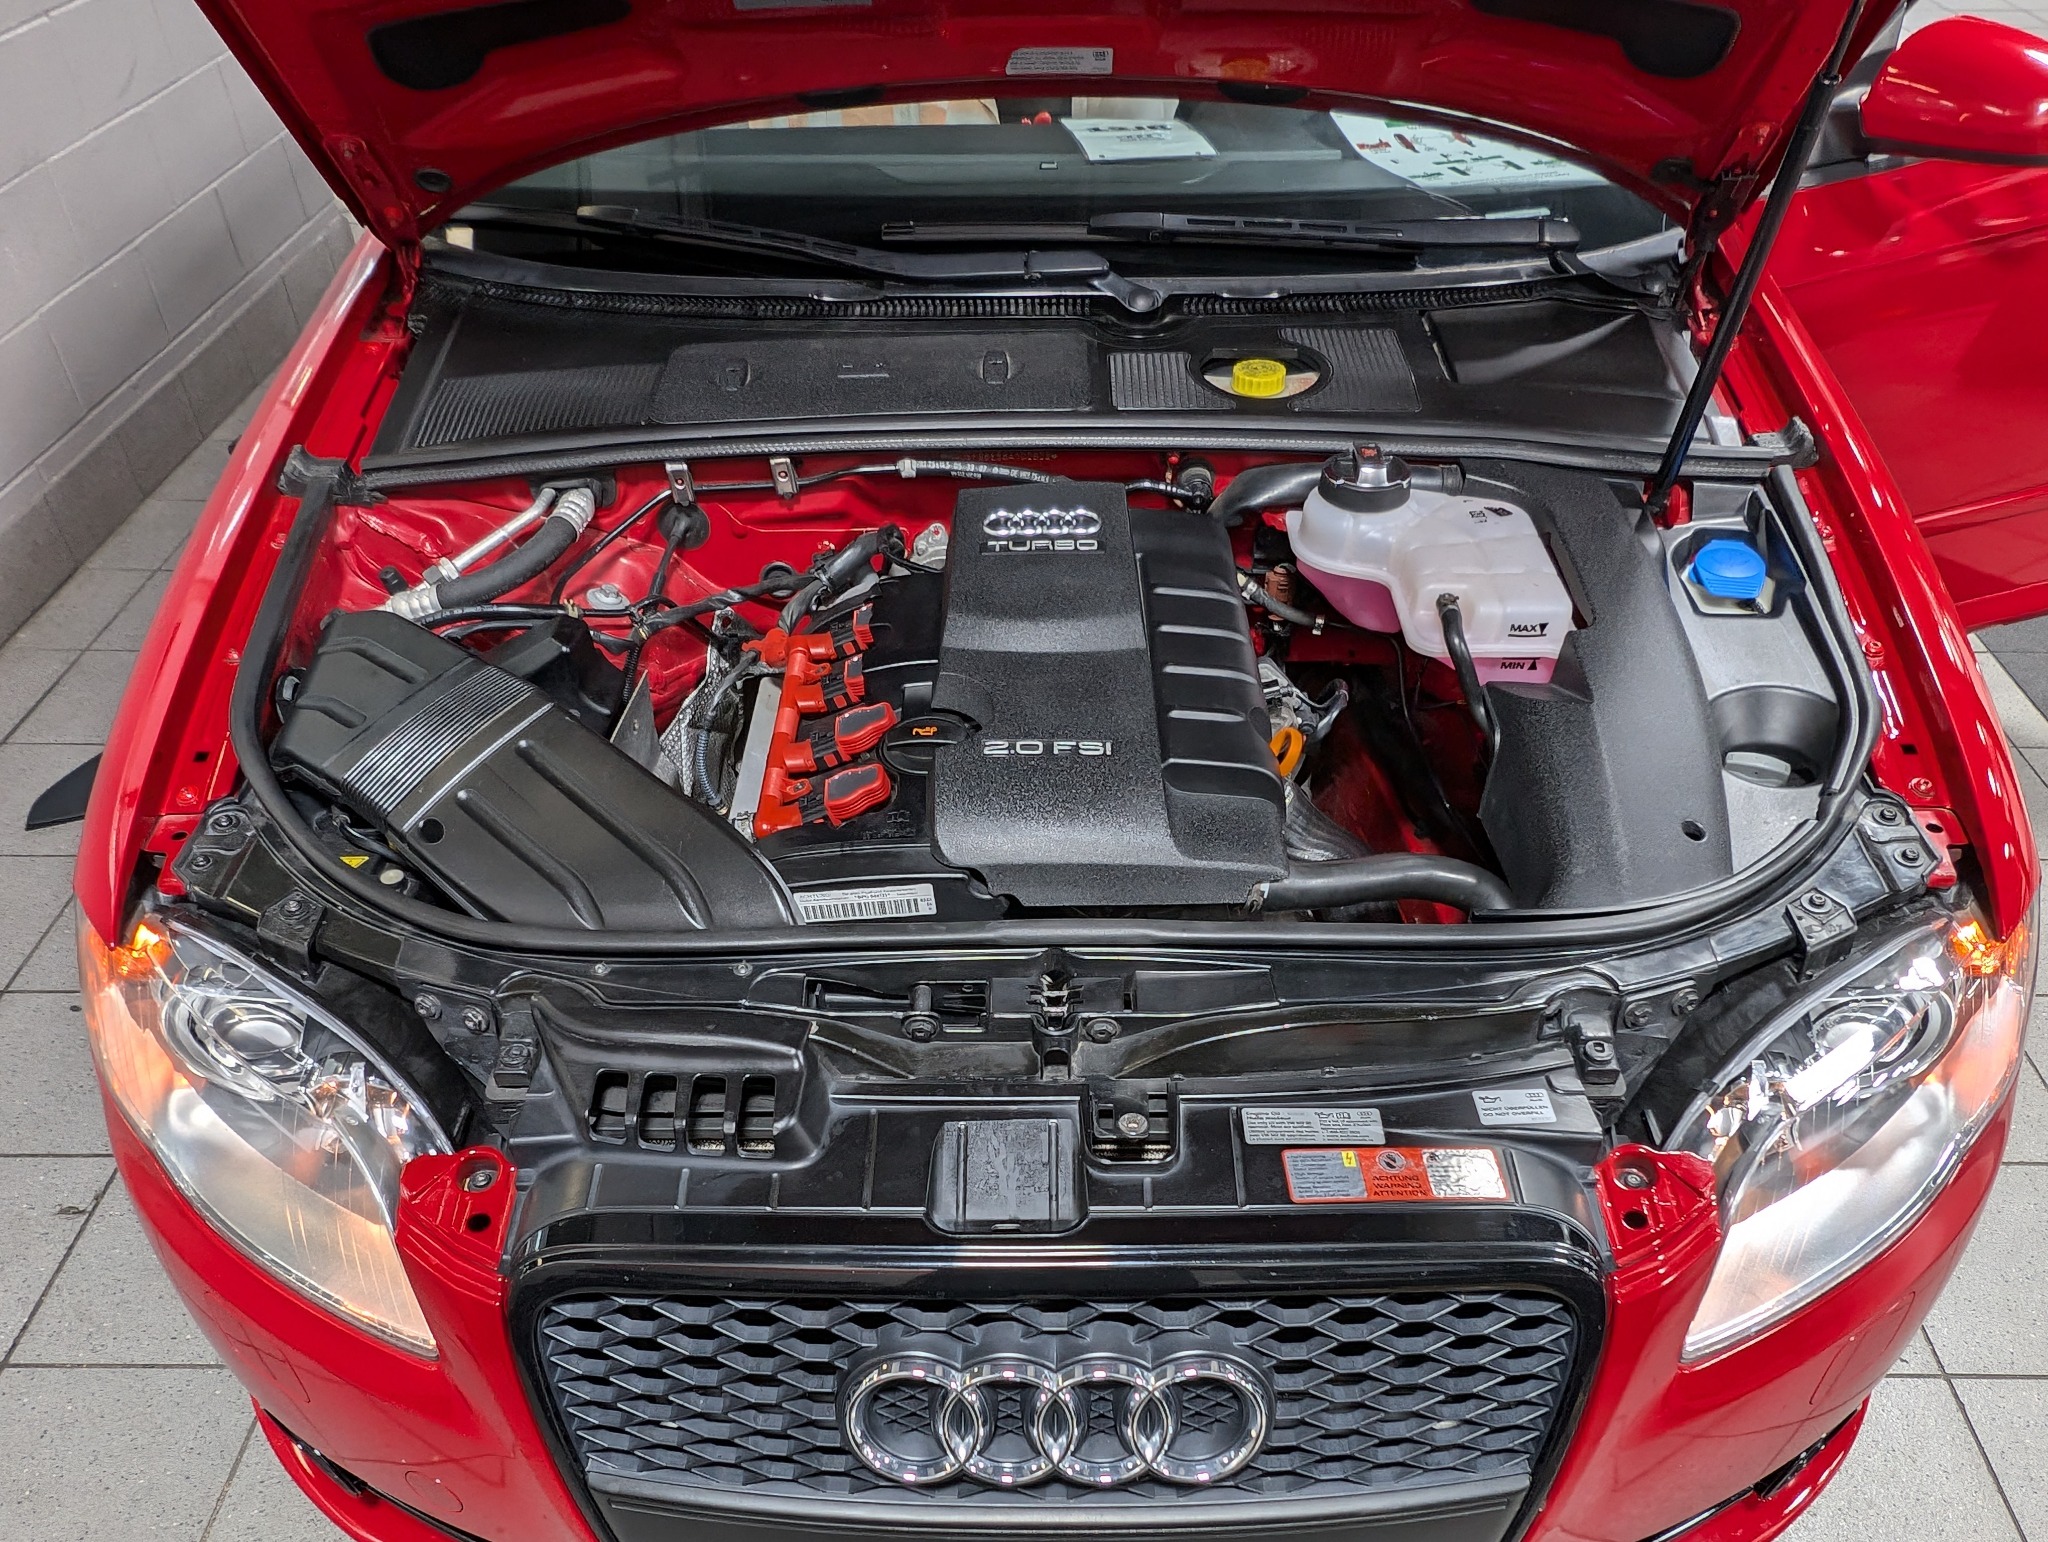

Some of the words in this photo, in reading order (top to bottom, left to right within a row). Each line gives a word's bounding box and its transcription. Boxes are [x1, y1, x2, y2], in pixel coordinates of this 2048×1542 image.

[987, 540, 1098, 552] TURBO
[1510, 623, 1538, 633] MAX
[1500, 661, 1526, 670] MIN
[983, 741, 1043, 755] 2.0
[1053, 741, 1112, 755] FSI
